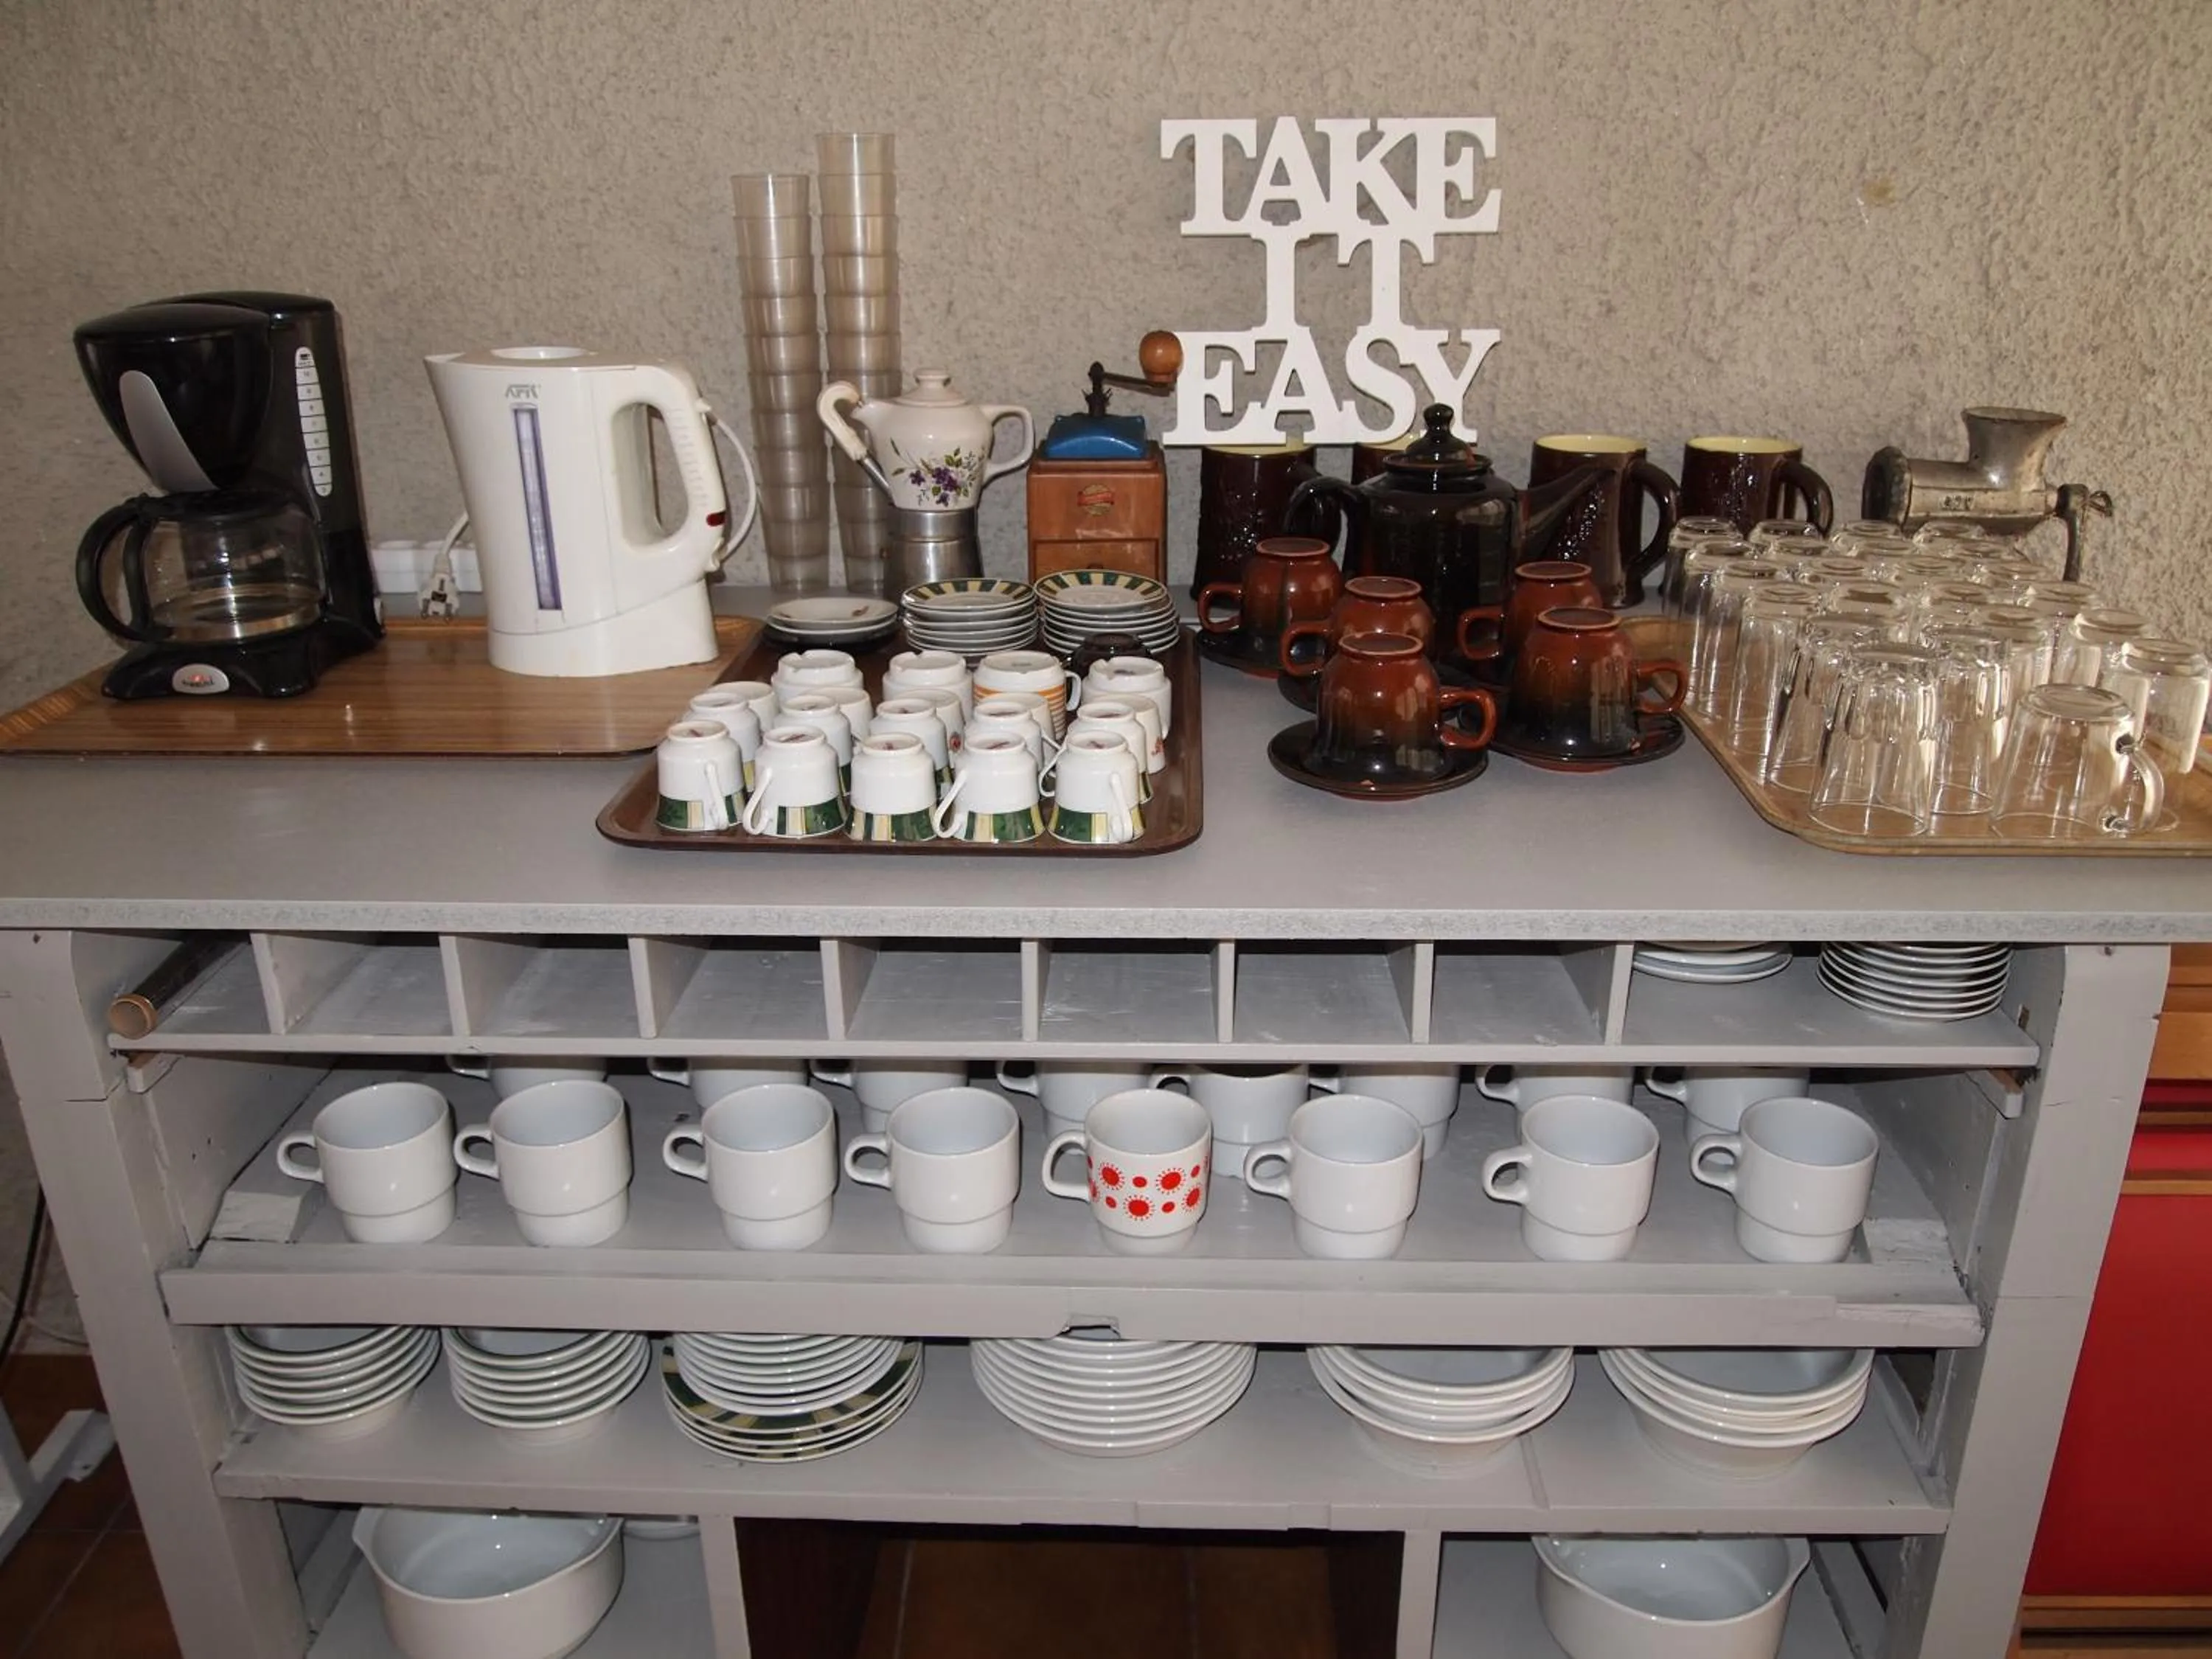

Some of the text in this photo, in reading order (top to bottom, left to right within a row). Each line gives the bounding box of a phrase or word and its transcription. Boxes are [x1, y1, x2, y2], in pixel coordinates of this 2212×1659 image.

[1161, 116, 1501, 234] TAKE
[1251, 232, 1434, 330] IT
[1163, 328, 1500, 445] EASY
